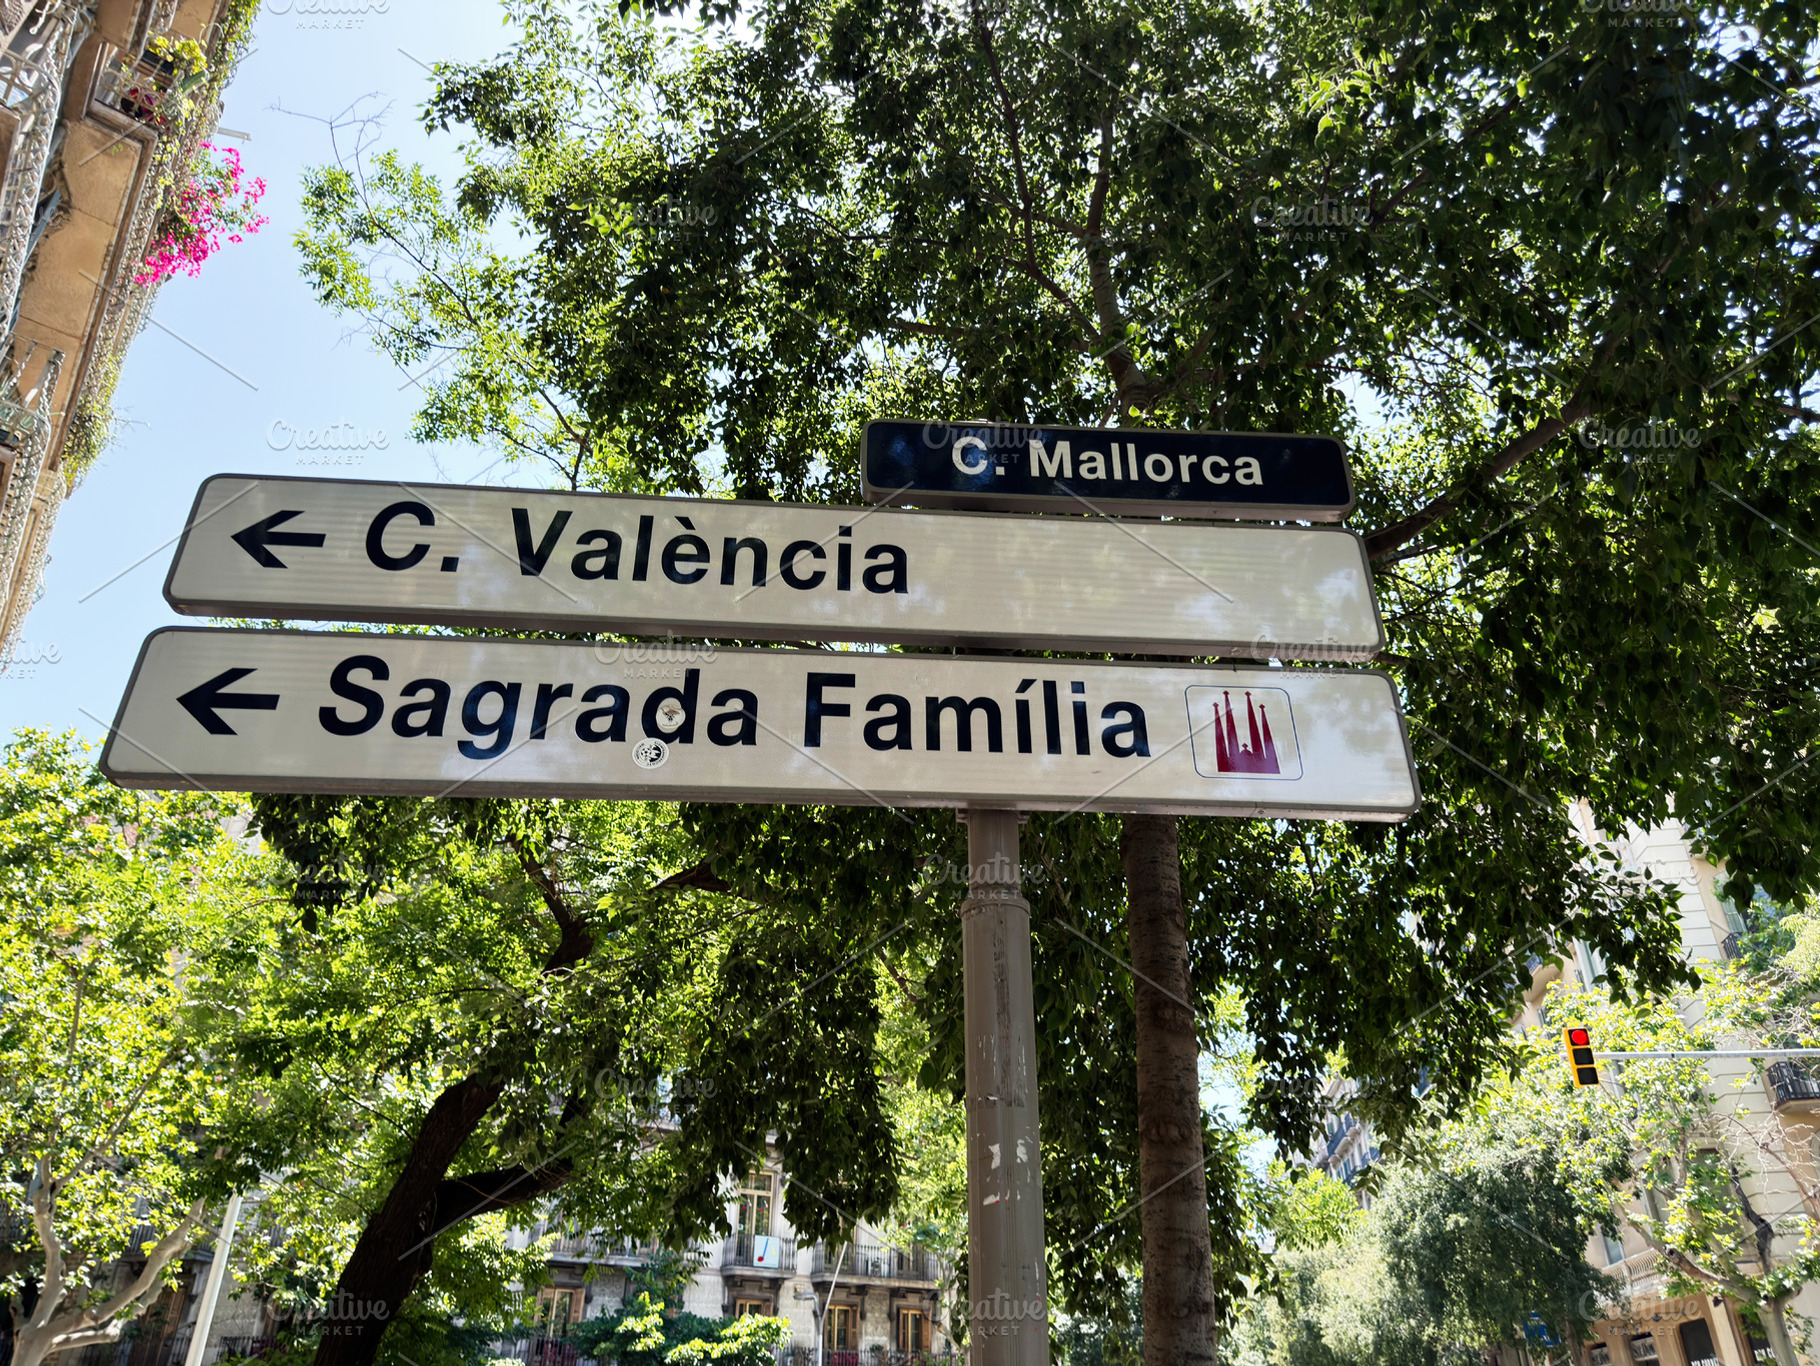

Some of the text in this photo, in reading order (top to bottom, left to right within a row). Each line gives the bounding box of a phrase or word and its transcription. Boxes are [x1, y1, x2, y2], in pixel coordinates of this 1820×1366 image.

[952, 436, 1264, 486] C. Mallorca
[365, 501, 909, 594] C. València
[318, 655, 1152, 760] Sagrada Família
